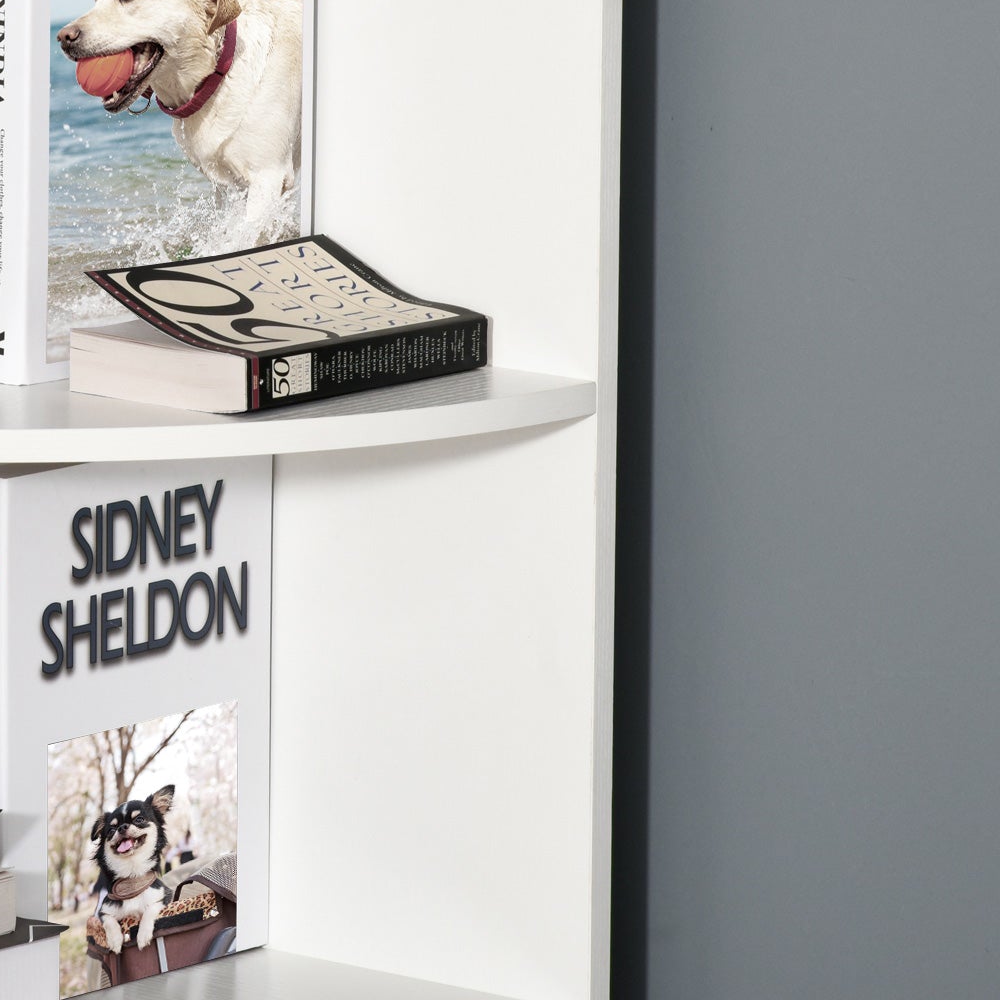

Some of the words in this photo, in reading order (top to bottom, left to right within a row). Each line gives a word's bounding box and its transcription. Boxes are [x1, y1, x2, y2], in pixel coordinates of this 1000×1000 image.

[126, 268, 340, 346] 50
[210, 264, 368, 332] GREAT
[248, 256, 408, 327] SHORT
[287, 246, 446, 320] STORIES
[274, 358, 290, 396] 50
[71, 479, 224, 580] SIDNEY
[42, 560, 248, 676] SHELDON
